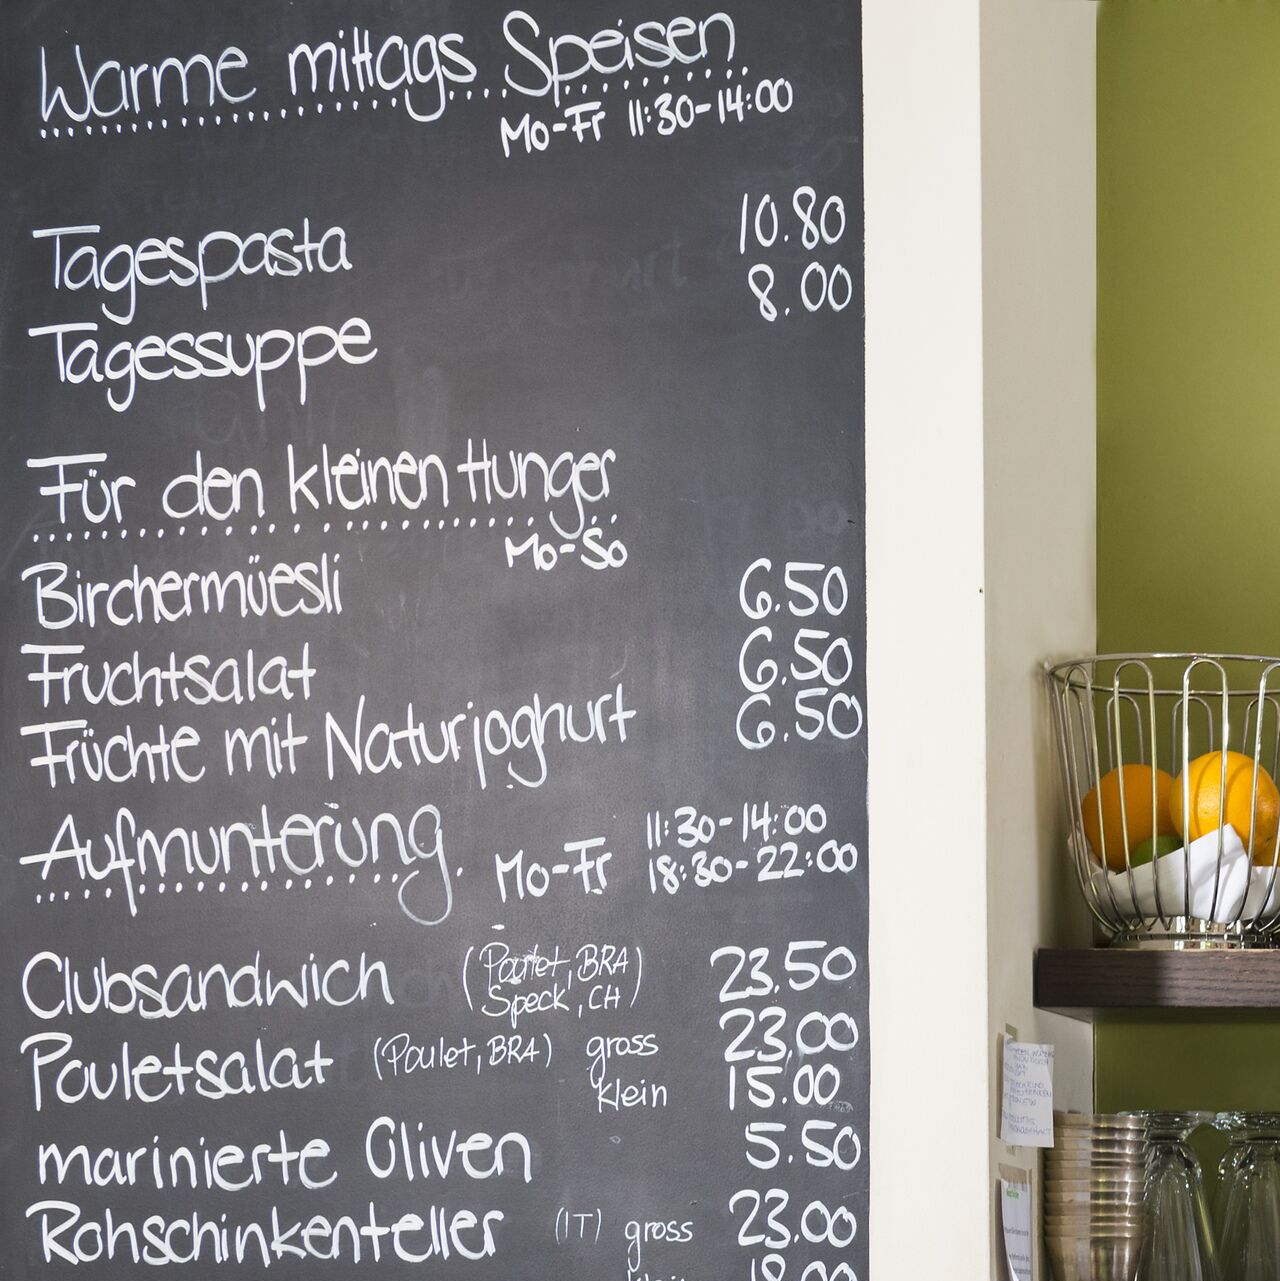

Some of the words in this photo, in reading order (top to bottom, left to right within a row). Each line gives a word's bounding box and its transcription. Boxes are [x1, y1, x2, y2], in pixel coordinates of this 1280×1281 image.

[40, 45, 258, 124] Warme
[289, 28, 477, 123] mittags
[502, 10, 736, 105] Speisen
[500, 104, 606, 158] Mo-Fr
[33, 217, 353, 325] Tagespasta
[739, 185, 846, 256] 10.80
[28, 317, 379, 412] Tagessuppe
[747, 261, 853, 322] 8.00
[26, 453, 137, 525] Für
[161, 449, 266, 522] den
[287, 442, 450, 513] kleinen
[457, 437, 618, 541] Hunger
[21, 554, 344, 630] Birchermüesli
[739, 557, 850, 619] 6.50
[506, 538, 628, 571] Mo-So
[19, 640, 317, 709] Fruchtsalat
[738, 626, 854, 694] 6.50
[19, 717, 207, 789] Früchte
[226, 716, 310, 776] mit
[324, 683, 638, 791] Naturjoghurt
[735, 687, 864, 751] 6.50
[19, 803, 455, 926] Aufmunterung
[496, 836, 612, 904] Mo-Fr
[21, 949, 397, 1020] Clubsandwich
[709, 940, 858, 1001] 23.50
[20, 1033, 335, 1110] Pouletsalat
[597, 1077, 669, 1113] klein
[728, 1066, 843, 1110] 15.00
[36, 1130, 339, 1192] marinierte
[364, 1115, 534, 1184] Oliven
[745, 1121, 862, 1172] 5.50
[25, 1199, 506, 1270] Rohschinkenteller
[728, 1188, 858, 1249] 23.00
